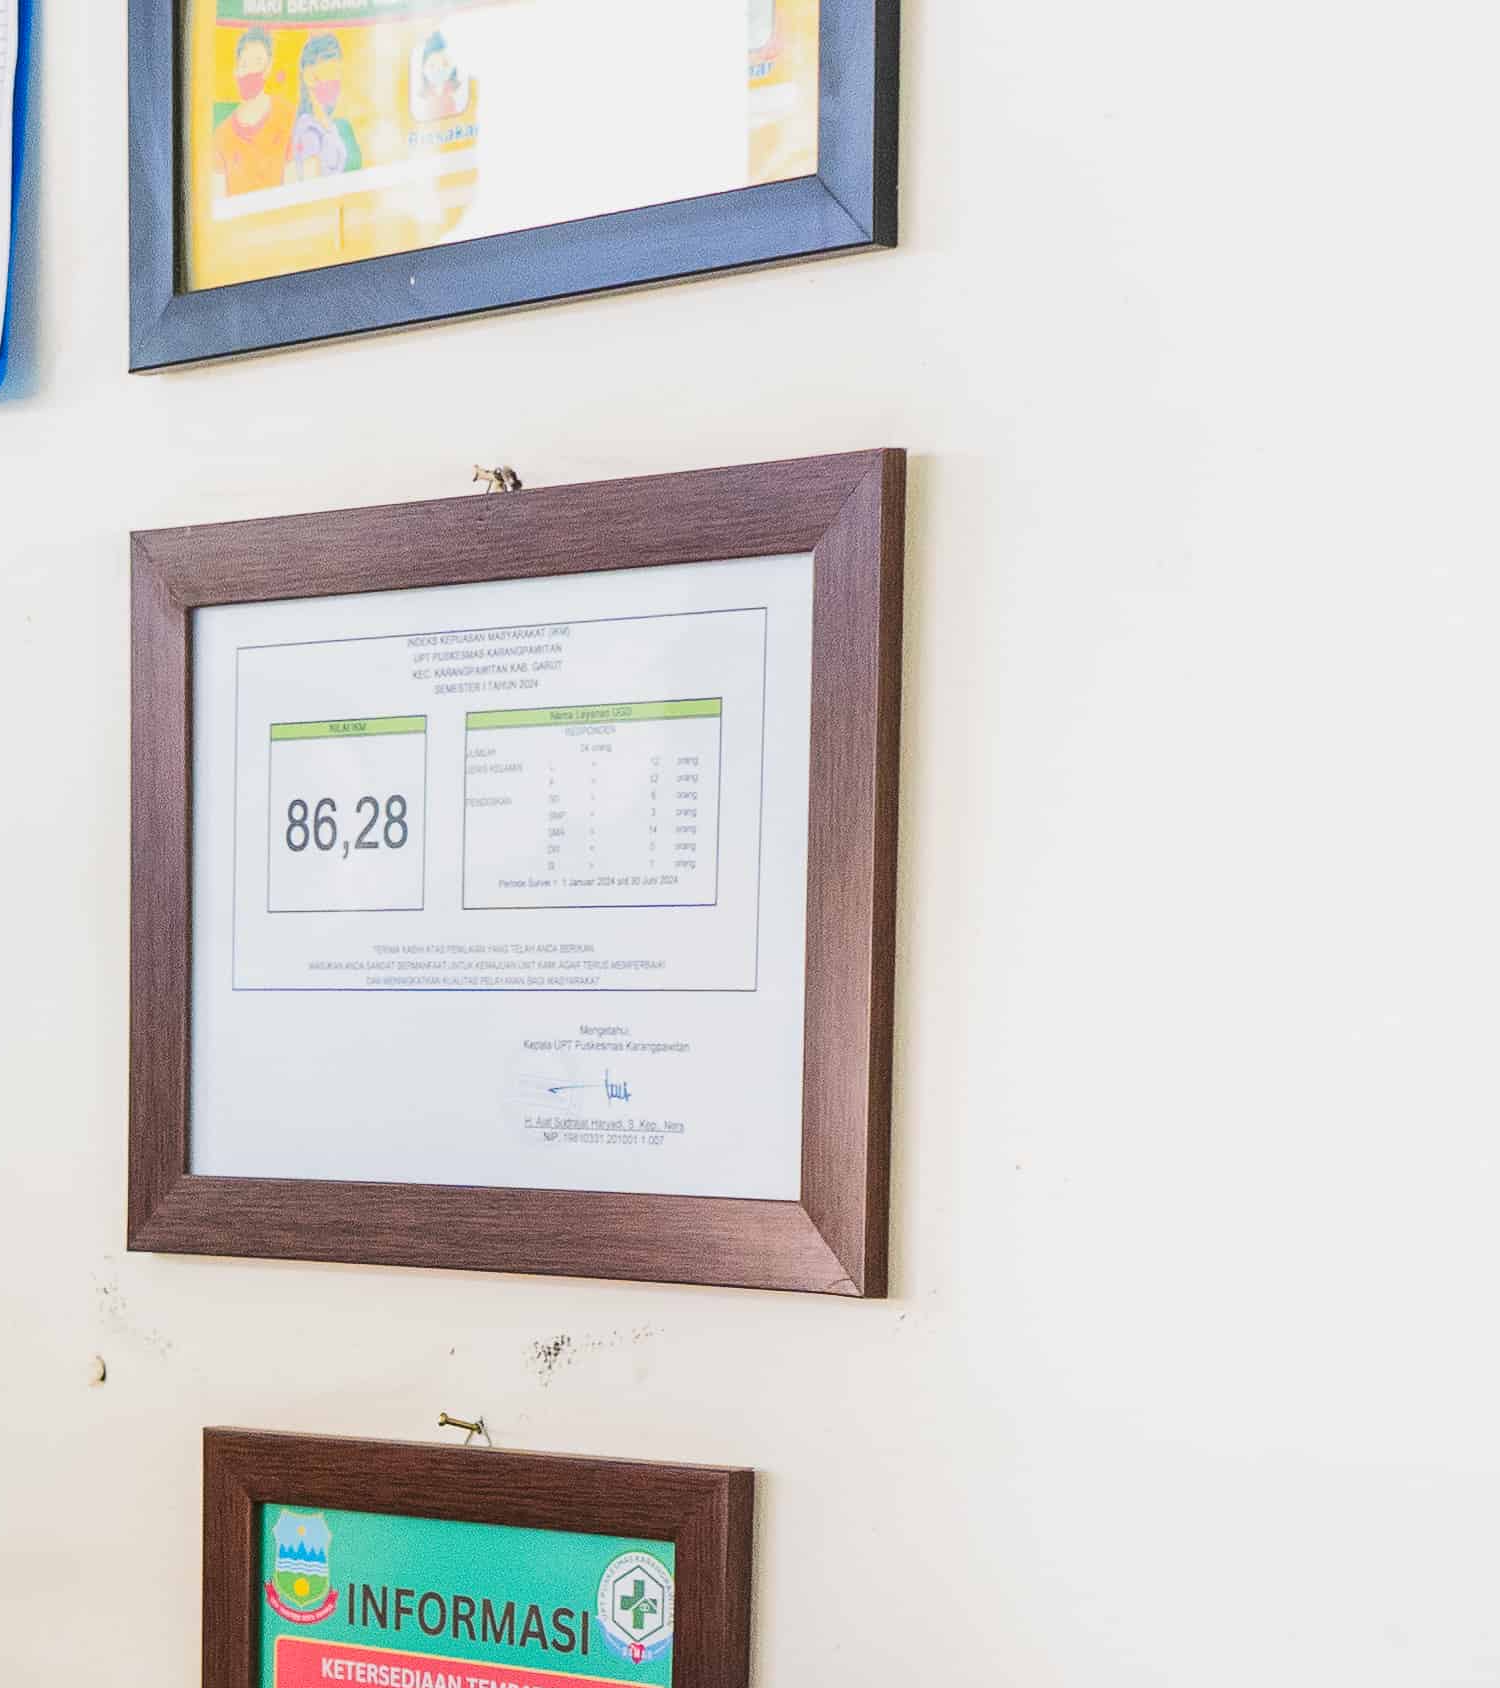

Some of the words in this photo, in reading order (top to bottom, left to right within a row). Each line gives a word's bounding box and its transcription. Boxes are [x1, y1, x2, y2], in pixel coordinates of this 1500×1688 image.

[488, 628, 546, 641] MASYARAKAT
[432, 648, 484, 661] PUSKESMAS
[487, 643, 562, 658] KARANGPAWITAN
[434, 664, 507, 678] KARANGPAWITAN
[434, 682, 481, 695] SEMESTER
[519, 679, 539, 689] 2024
[286, 794, 408, 860] 86,28
[348, 1582, 590, 1656] INFORMASI
